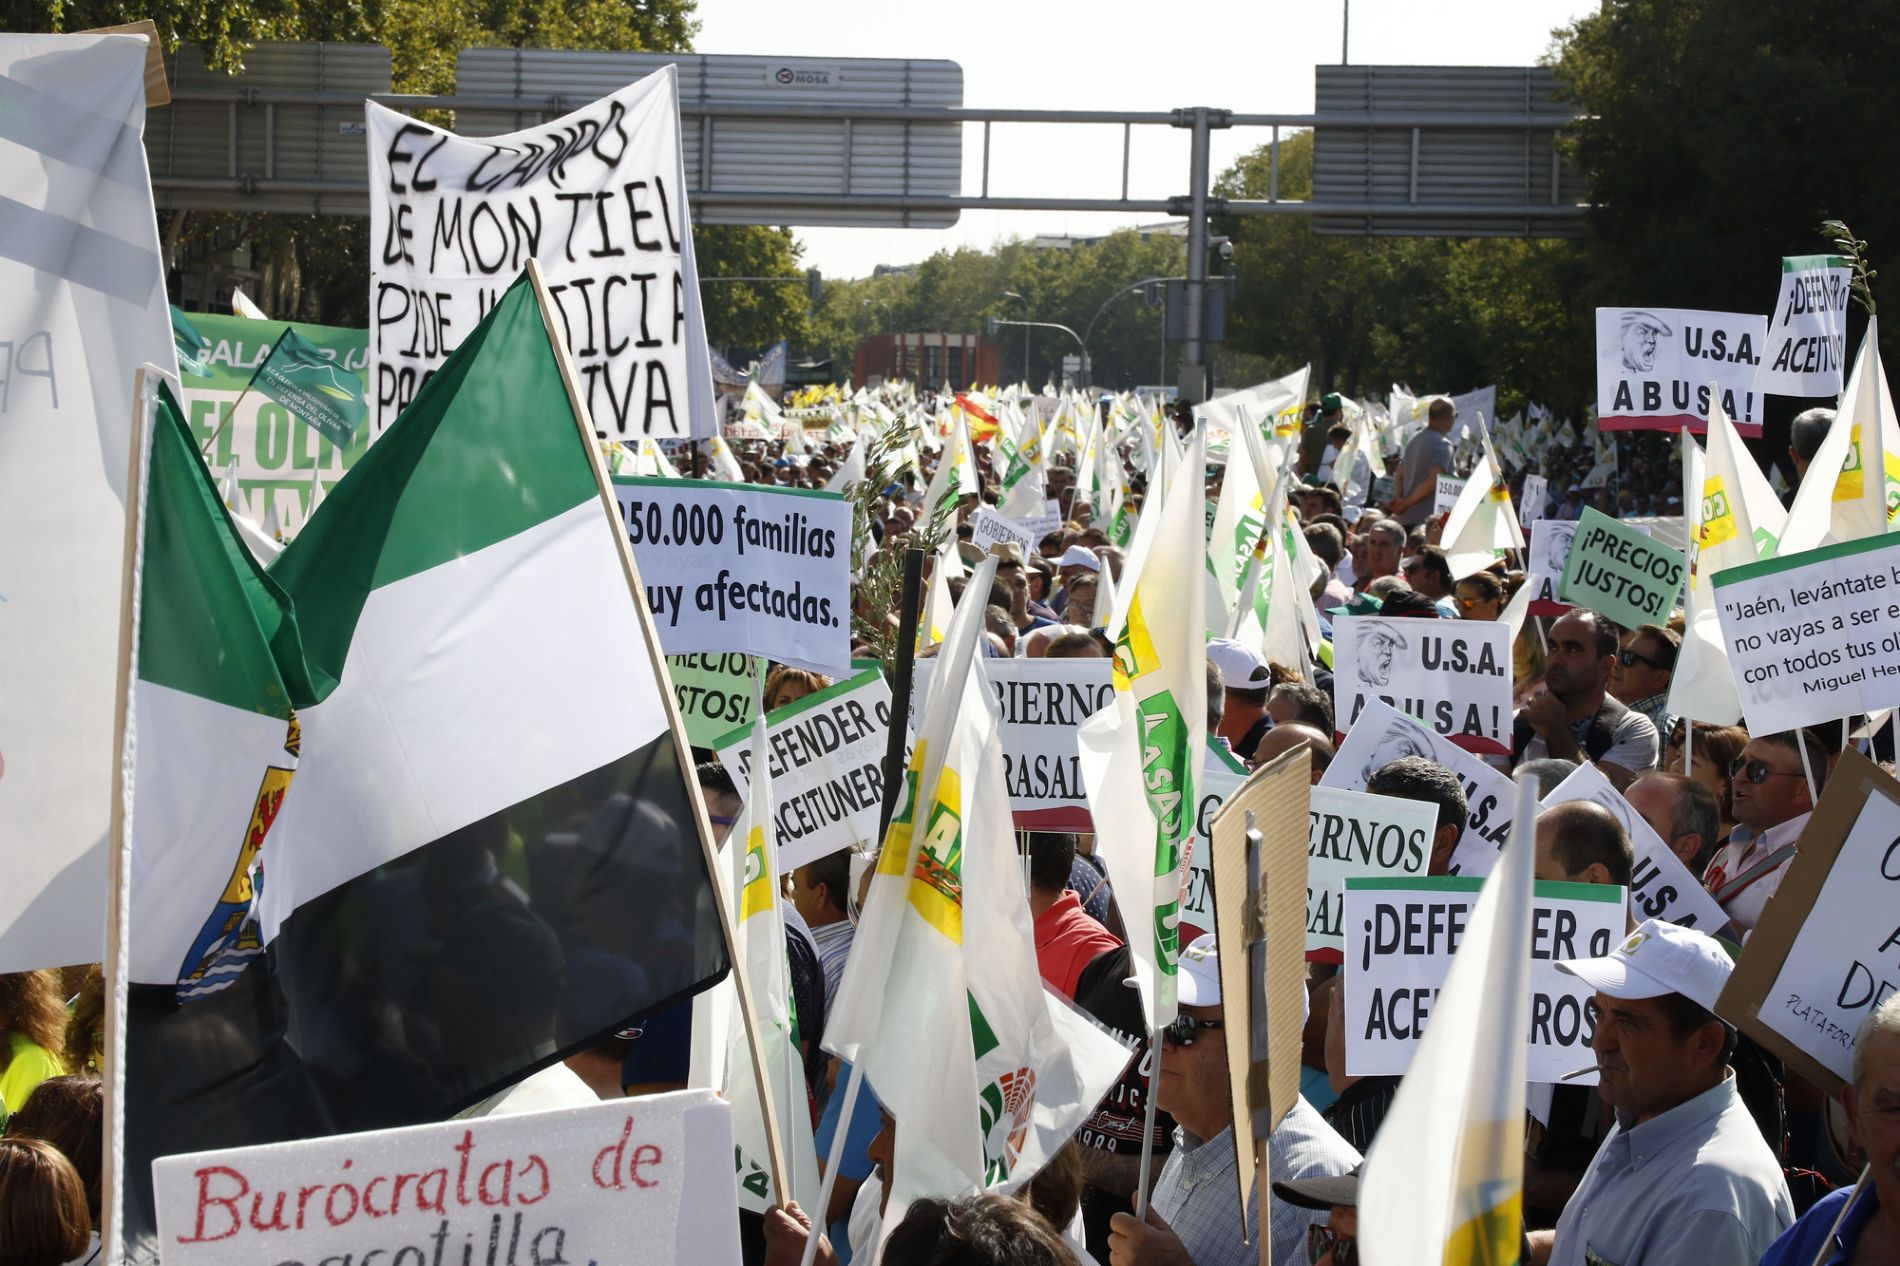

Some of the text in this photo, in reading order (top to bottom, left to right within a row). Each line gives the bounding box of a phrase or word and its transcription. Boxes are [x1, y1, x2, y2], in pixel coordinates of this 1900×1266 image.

[388, 123, 448, 193] EL
[377, 281, 455, 358] PIDE
[1685, 326, 1760, 365] U.S.A.
[279, 395, 322, 428] DE MONTAÑA
[305, 402, 318, 416] DEL
[318, 412, 342, 432] OLIVAR
[1613, 380, 1753, 423] ABUSA!
[732, 504, 836, 559] familias
[1581, 527, 1683, 586] ¡PRECIOS
[646, 569, 840, 629] uy afectadas.
[1573, 559, 1665, 617] JUSTOS!
[1790, 574, 1887, 608] levántate
[1735, 634, 1762, 653] no
[1766, 619, 1825, 646] vayas
[1832, 615, 1844, 631] a
[1850, 606, 1880, 627] ser
[1421, 636, 1505, 677] U.S.A.
[1744, 663, 1779, 684] con
[1783, 649, 1841, 674] todos
[1845, 640, 1876, 660] tus
[1803, 668, 1867, 693] Miguel
[1362, 903, 1578, 972] ¡DEFEER
[1589, 928, 1611, 958] a
[591, 1115, 663, 1191] de
